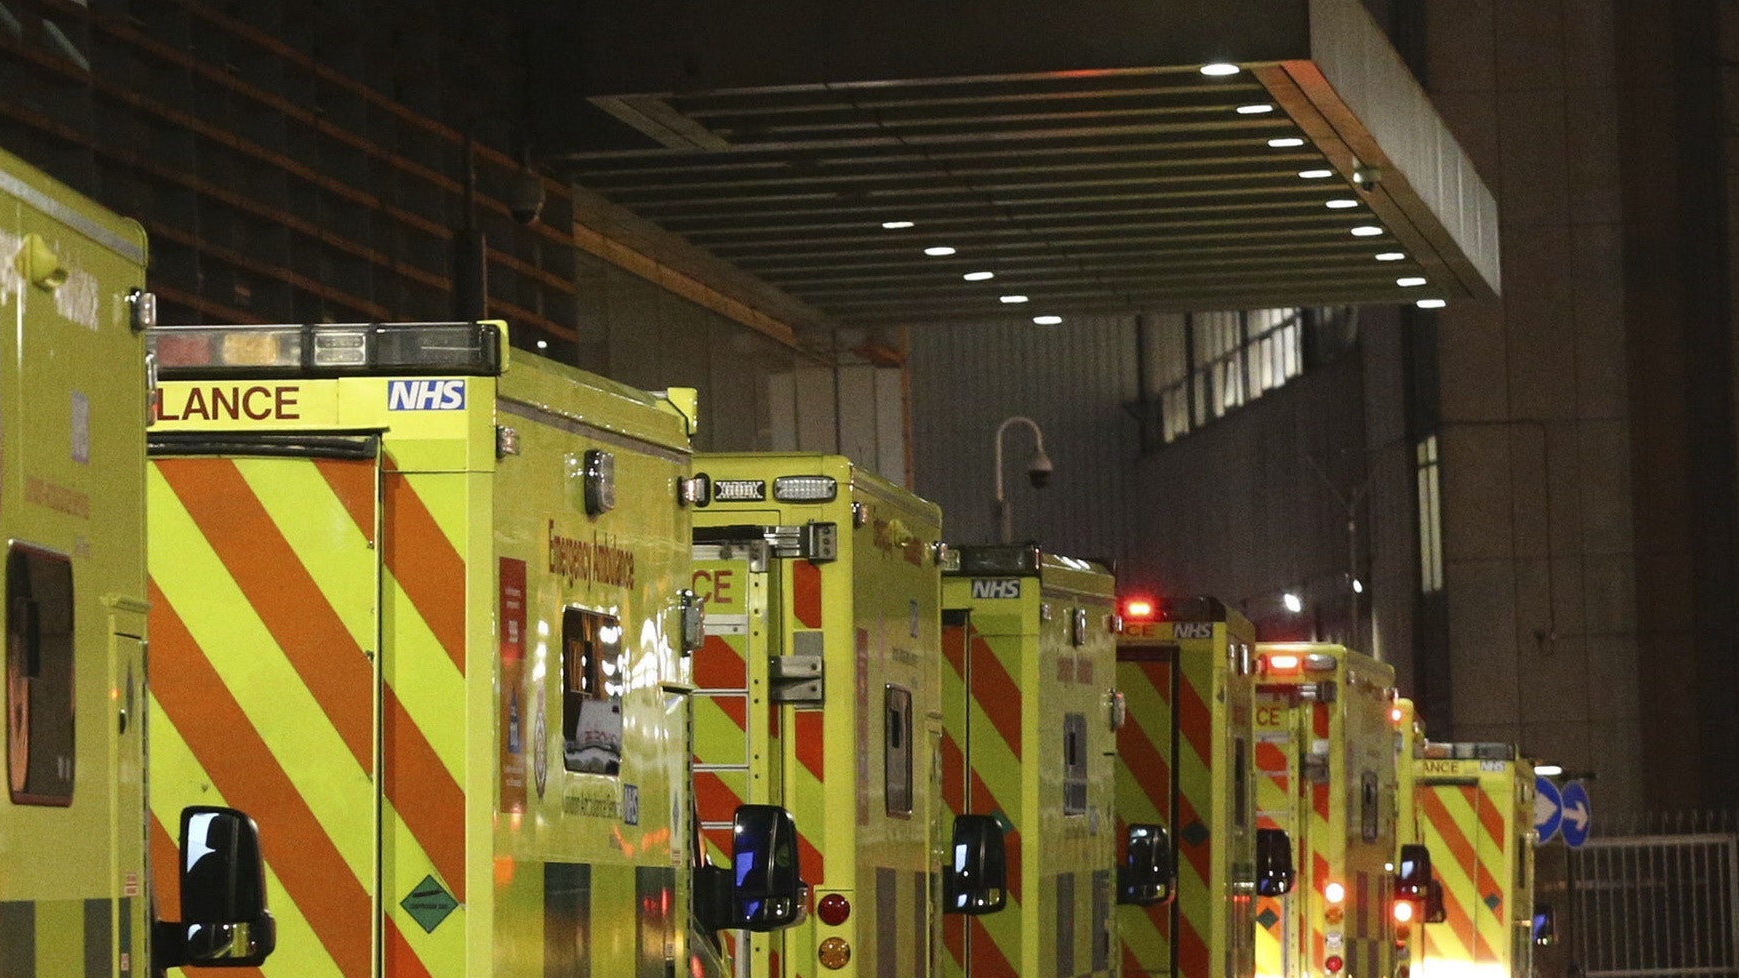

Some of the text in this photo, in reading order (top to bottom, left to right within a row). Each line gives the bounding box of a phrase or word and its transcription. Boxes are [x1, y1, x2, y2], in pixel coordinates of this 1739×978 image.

[157, 380, 464, 421] LANCE NHS
[548, 518, 592, 591] Emergency
[972, 579, 1020, 598] NHS
[1173, 622, 1211, 638] NHS
